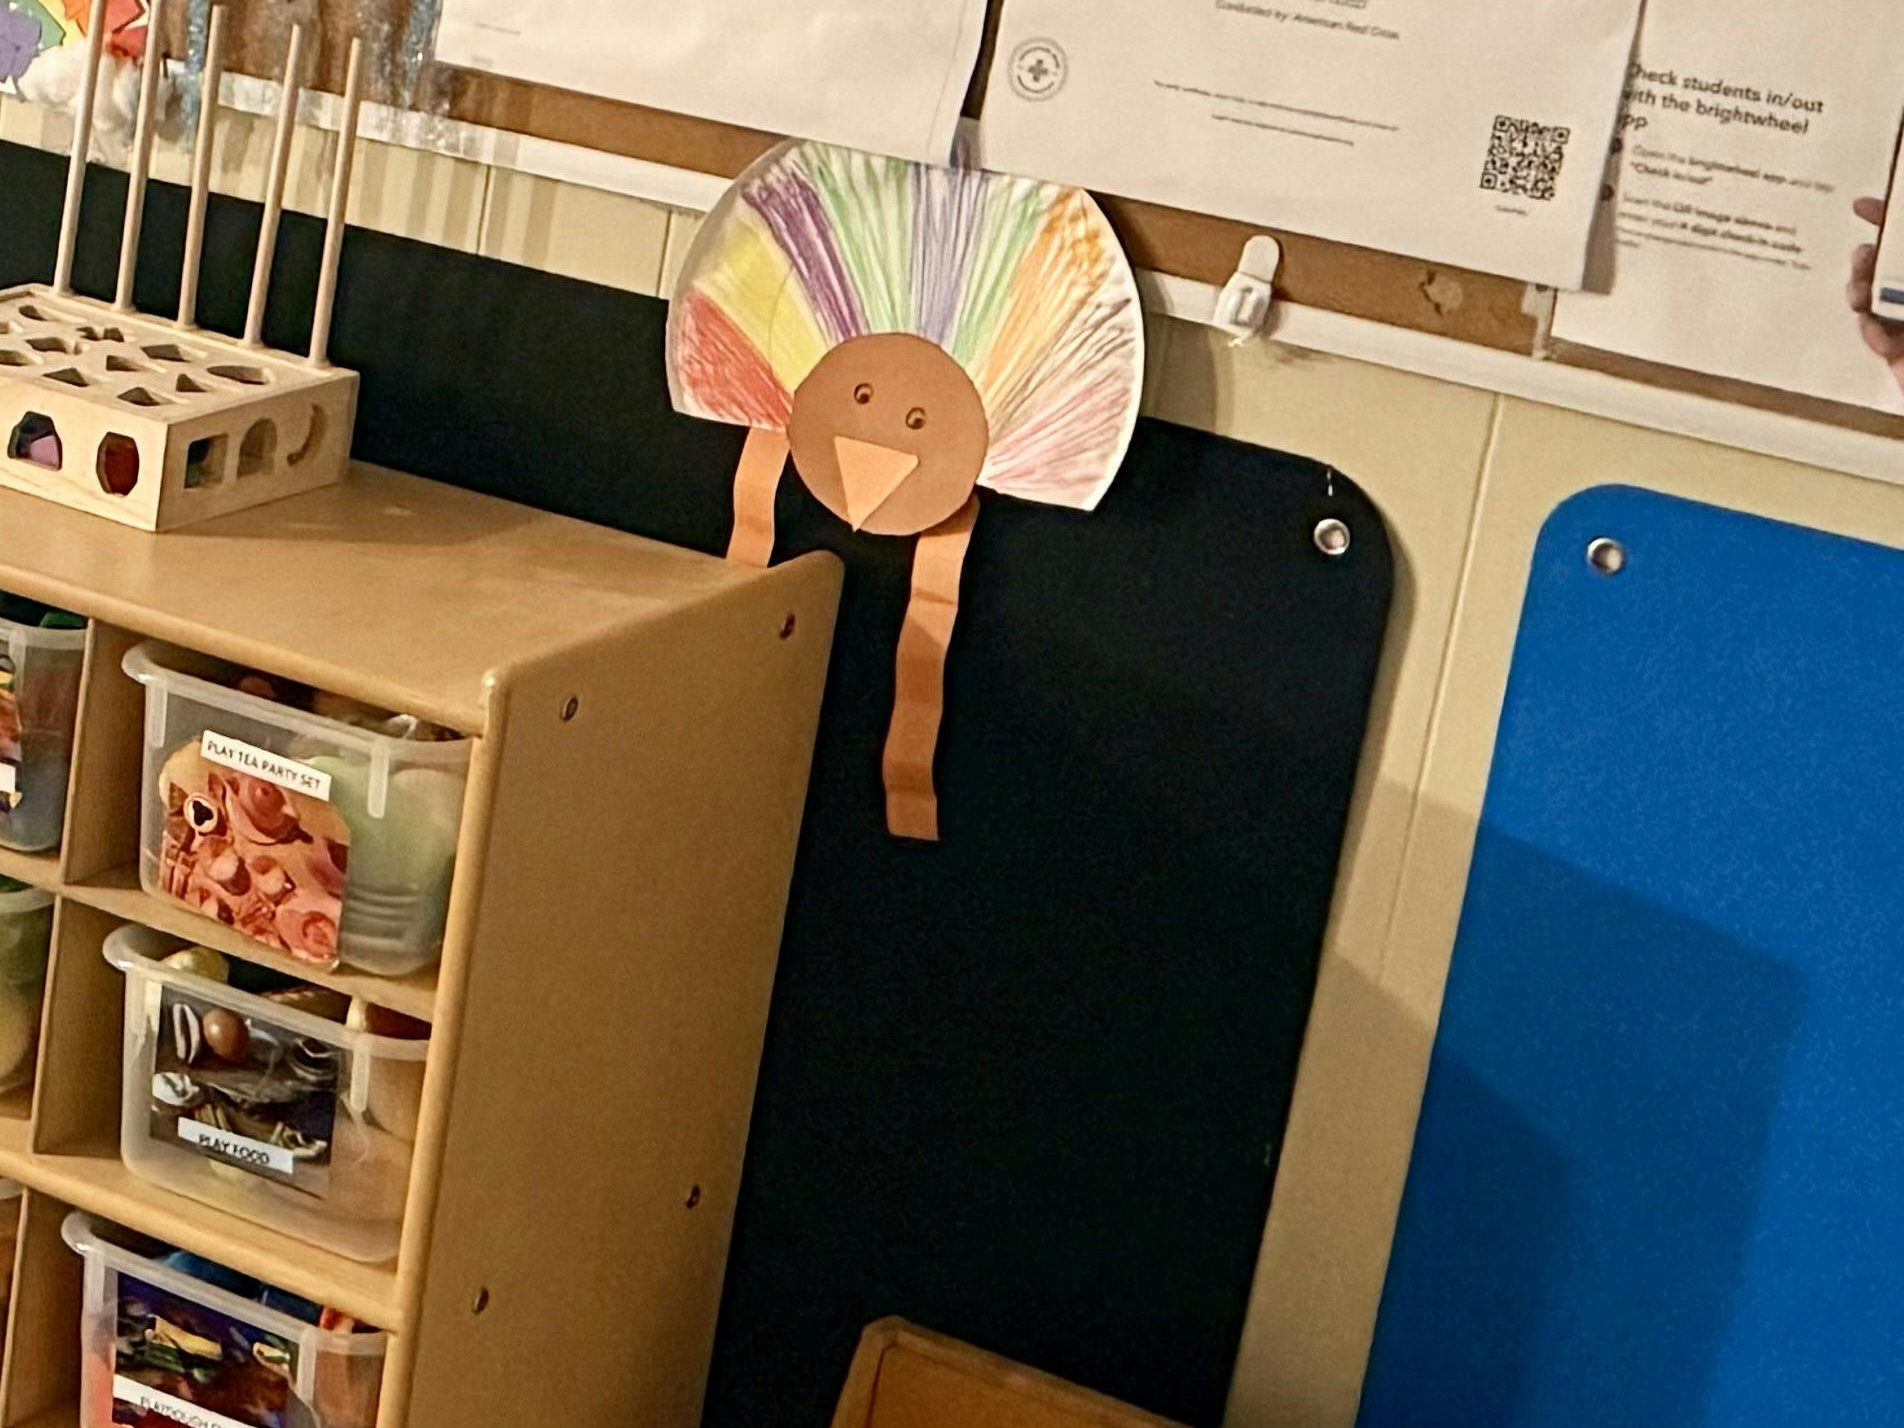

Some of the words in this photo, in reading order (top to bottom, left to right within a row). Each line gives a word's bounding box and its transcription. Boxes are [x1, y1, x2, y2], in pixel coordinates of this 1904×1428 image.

[1661, 93, 1691, 113] the
[1695, 98, 1810, 135] brightwheel
[1683, 76, 1762, 103] students
[1766, 89, 1825, 115] in/out
[1621, 113, 1649, 132] pp
[206, 739, 234, 760] PLAY
[237, 748, 259, 771] TEA
[260, 757, 299, 783] PARTY
[299, 771, 322, 790] SET
[199, 1133, 230, 1154] PLAY
[232, 1143, 271, 1165] FOOD
